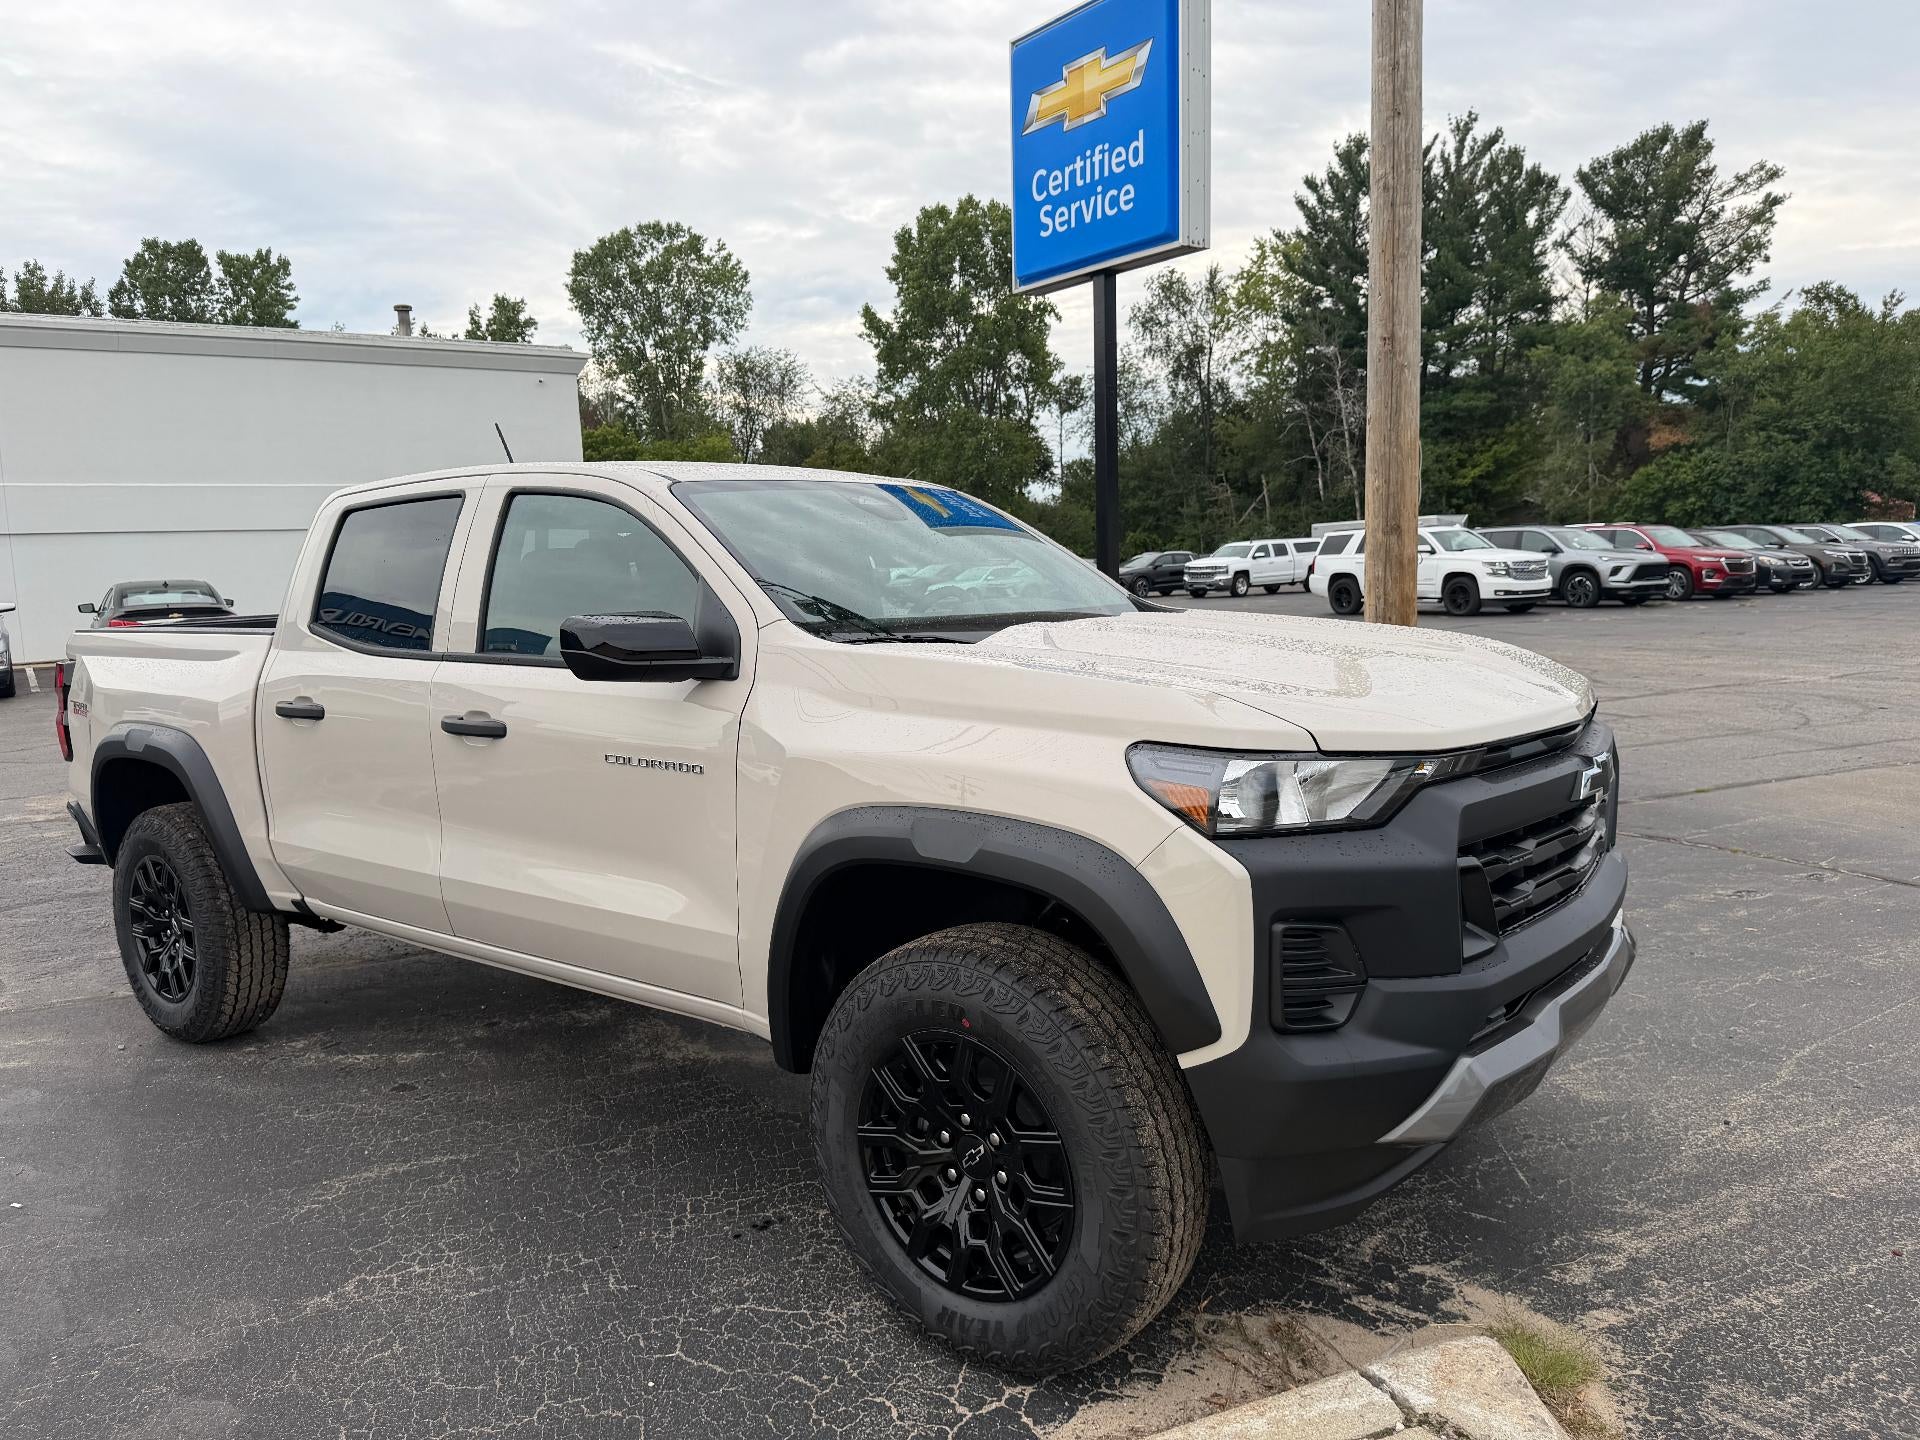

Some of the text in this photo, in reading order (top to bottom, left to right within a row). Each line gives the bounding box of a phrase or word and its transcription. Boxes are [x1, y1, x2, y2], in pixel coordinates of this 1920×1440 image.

[1031, 129, 1144, 202] Certified
[1039, 183, 1136, 238] Service
[604, 753, 705, 775] COLORADO
